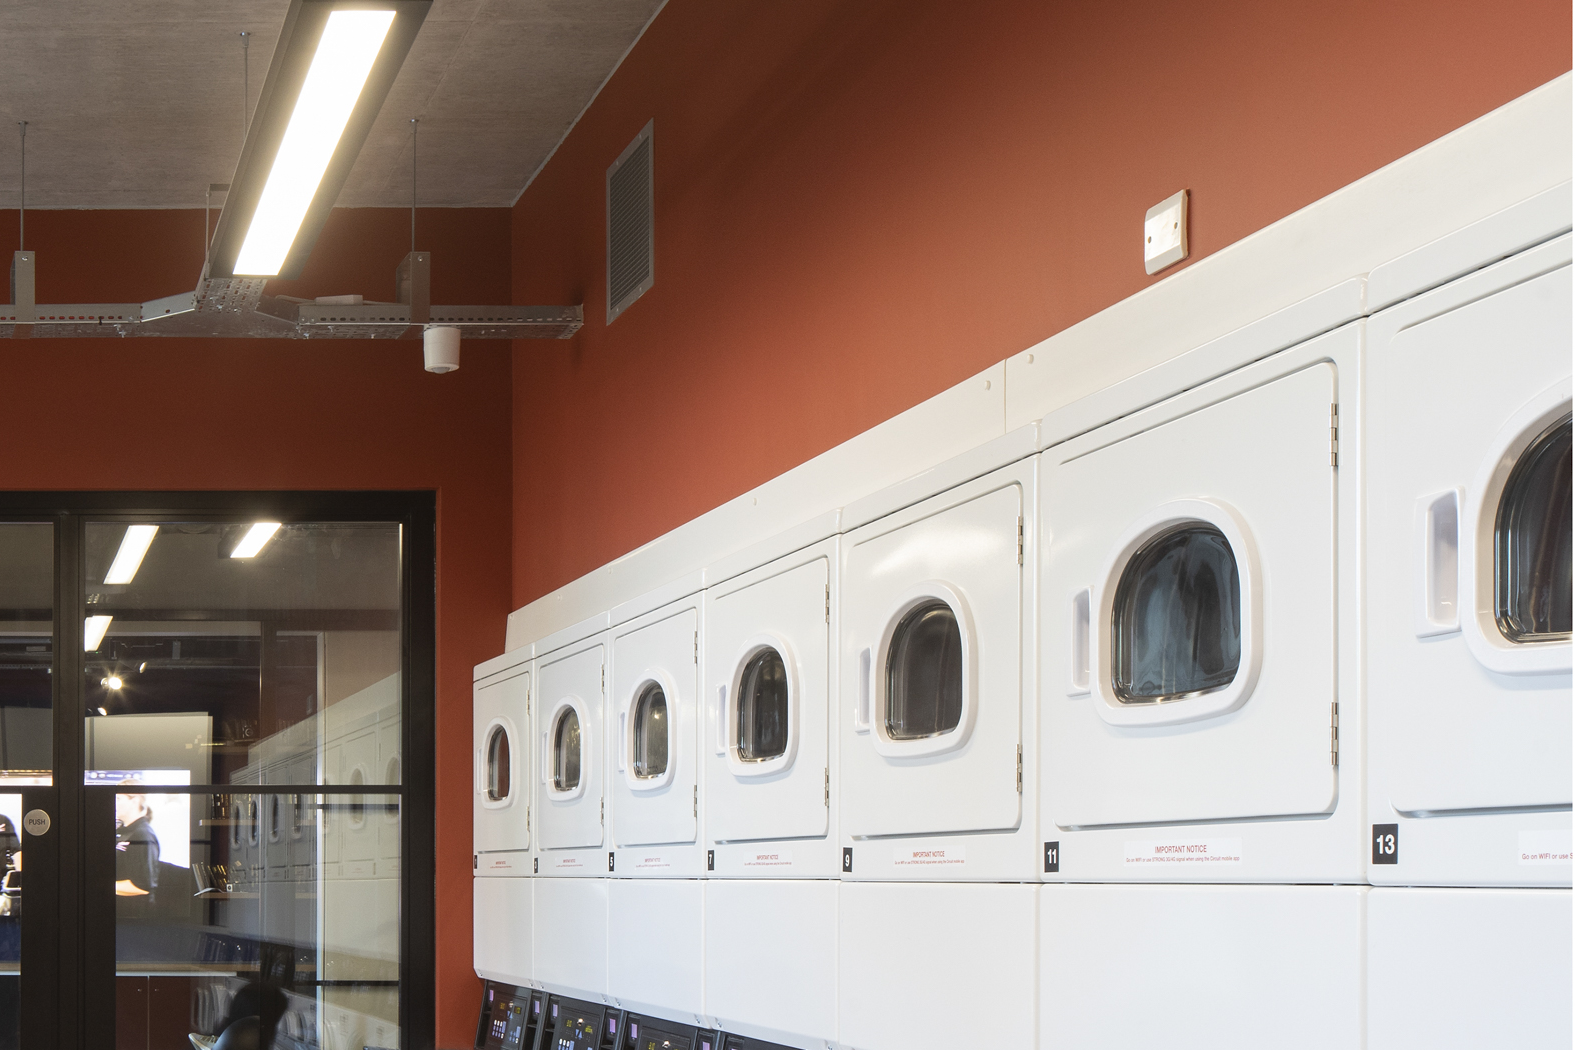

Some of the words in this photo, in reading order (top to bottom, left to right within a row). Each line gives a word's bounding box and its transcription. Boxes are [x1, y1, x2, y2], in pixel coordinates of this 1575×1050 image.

[1376, 834, 1395, 854] 13
[845, 854, 850, 867] 9
[1047, 849, 1057, 864] 11
